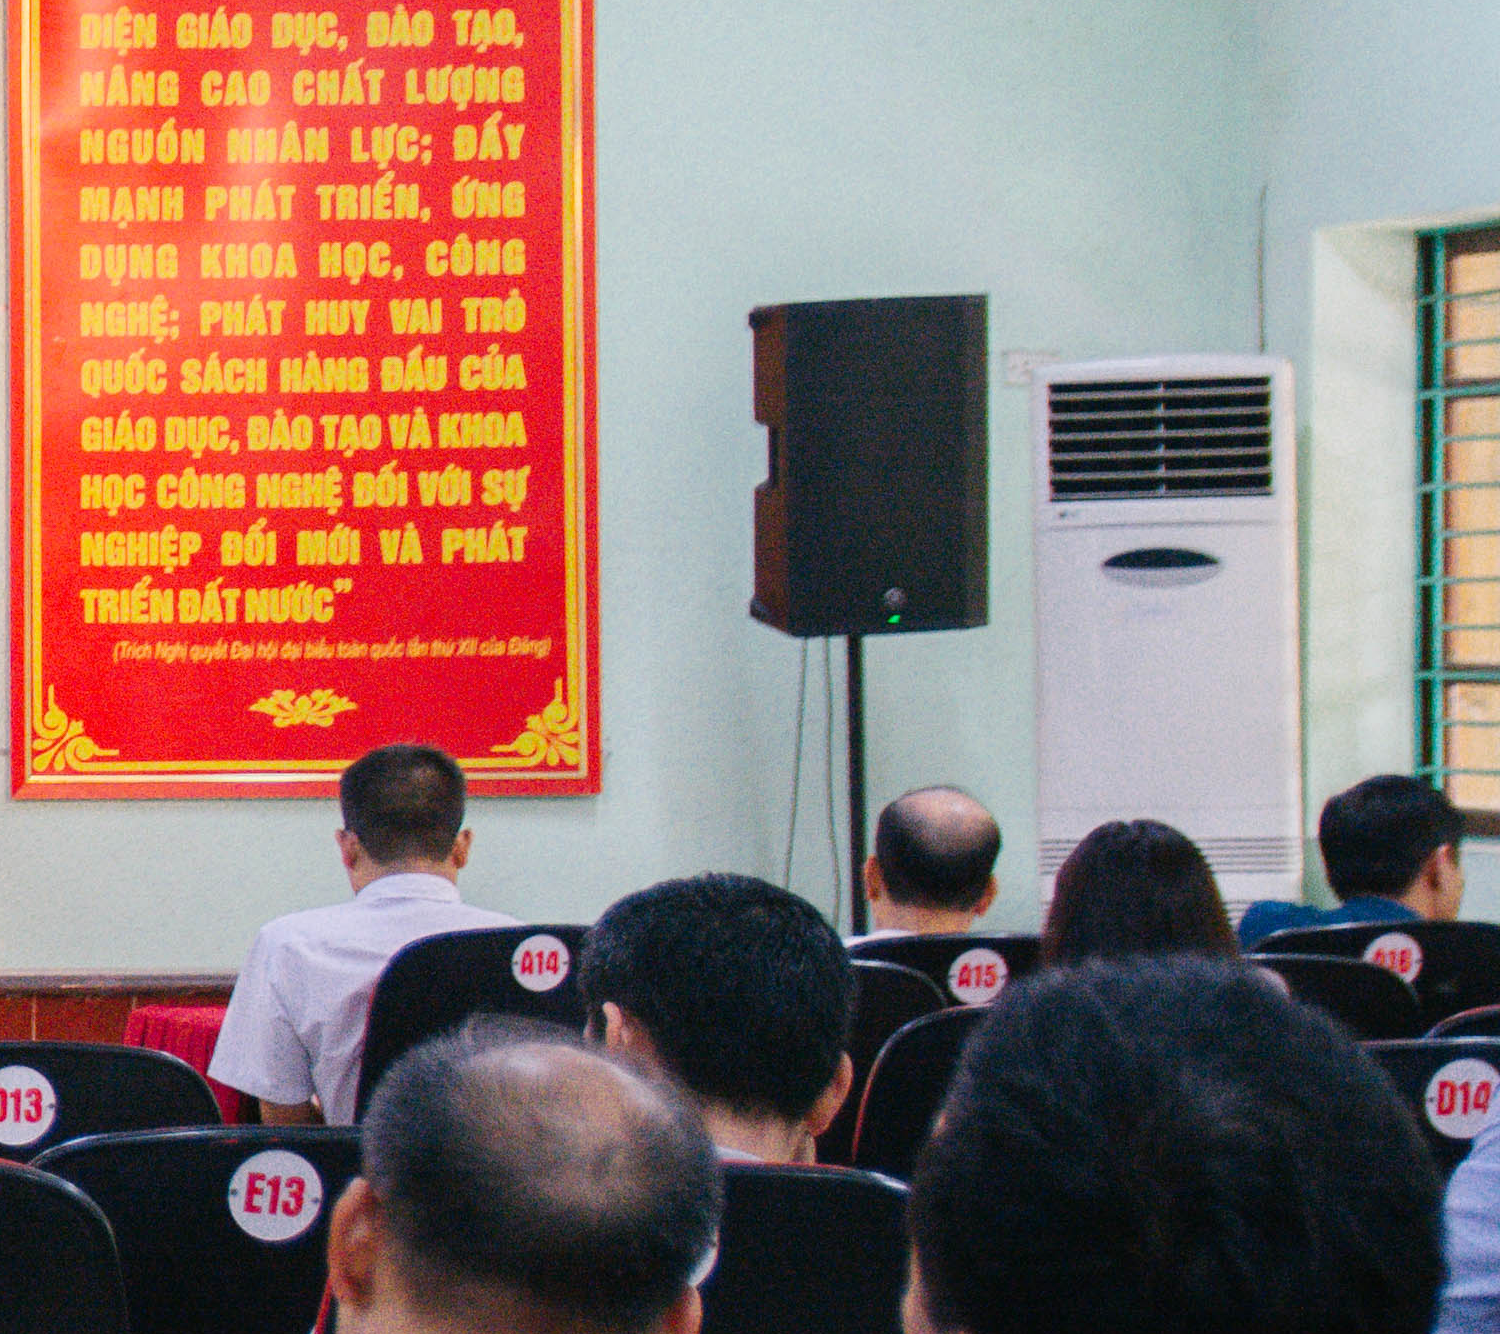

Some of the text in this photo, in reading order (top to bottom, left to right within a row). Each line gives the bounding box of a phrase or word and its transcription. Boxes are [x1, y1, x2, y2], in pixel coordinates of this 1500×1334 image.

[80, 58, 524, 110] NÂNG CAO CHẤT LƯỢNG
[80, 172, 525, 226] MẠNH PHÁT TRIỂN, ỨNG
[80, 234, 525, 284] DỤNG KHOA HỌC, CÔNG
[80, 290, 526, 342] NGHỆ; PHÁT HUY VAI TRÒ
[520, 950, 559, 975] A14
[957, 960, 997, 988] A15
[1436, 1080, 1491, 1116] D14
[244, 1174, 304, 1216] E13
